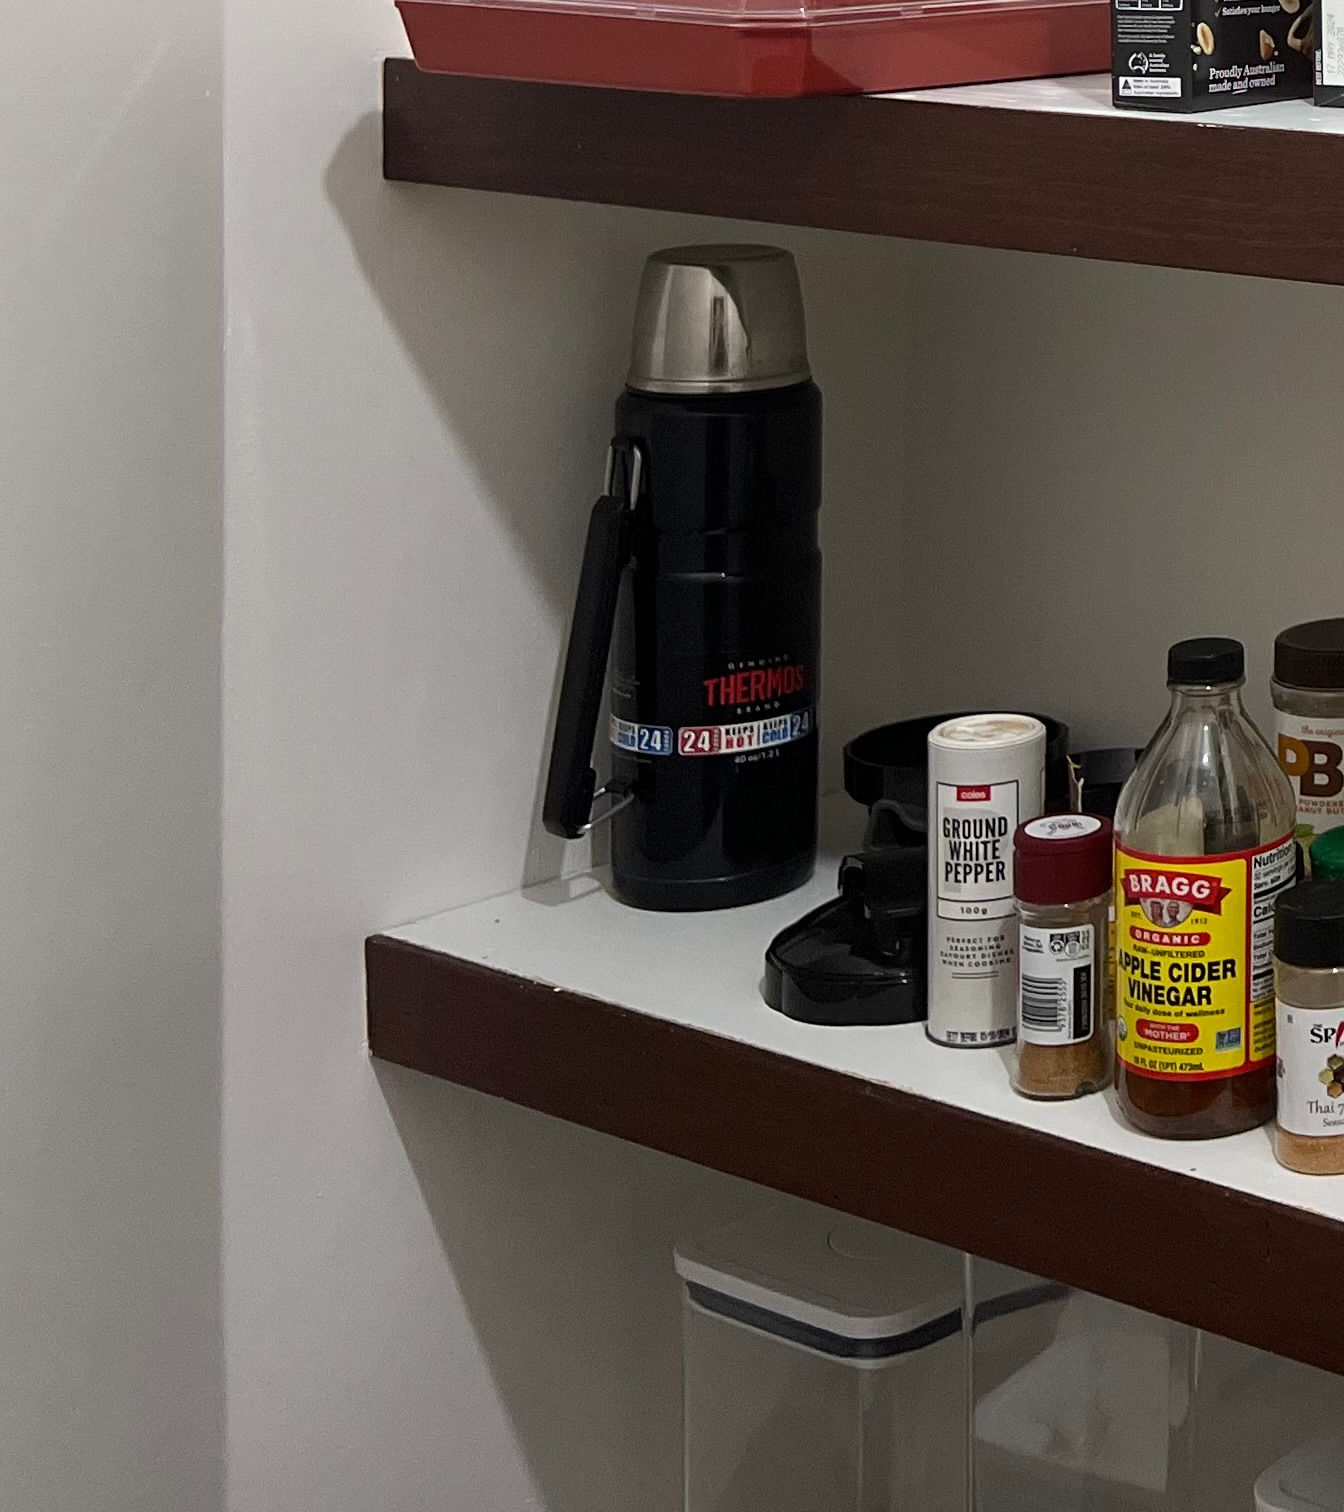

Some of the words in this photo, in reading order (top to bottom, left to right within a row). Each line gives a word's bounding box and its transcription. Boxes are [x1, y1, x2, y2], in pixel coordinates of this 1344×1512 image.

[1222, 6, 1247, 16] Satisfies
[1209, 66, 1242, 80] Proudly
[1243, 62, 1285, 76] Australian
[1209, 80, 1231, 92] made
[1232, 78, 1248, 90] and
[1249, 74, 1276, 87] owned
[704, 665, 804, 706] THERMOS
[737, 701, 780, 715] BRAND
[725, 725, 754, 736] KEEPS
[762, 719, 788, 732] KEEPS
[639, 729, 661, 750] 24
[683, 731, 711, 752] 24
[725, 735, 754, 749] HOT
[762, 730, 788, 744] COLD
[961, 791, 986, 799] coles
[943, 816, 1008, 839] GROUND
[949, 839, 1000, 861] WHITE
[945, 861, 1006, 883] PEPPER
[1129, 874, 1211, 898] BRAGG
[960, 907, 988, 915] 100g
[946, 936, 983, 944] PERFECT
[1135, 931, 1200, 943] ORGANIC
[1118, 950, 1161, 981] APPLE
[1168, 959, 1236, 983] CIDER
[1128, 978, 1212, 1006] VINEGAR
[1135, 1005, 1151, 1015] daily
[1152, 1008, 1172, 1016] dose
[1174, 1008, 1183, 1017] of
[1185, 1008, 1225, 1017] wellness
[1134, 1042, 1203, 1055] UNPASTEURIZED
[1307, 1099, 1335, 1114] Thai
